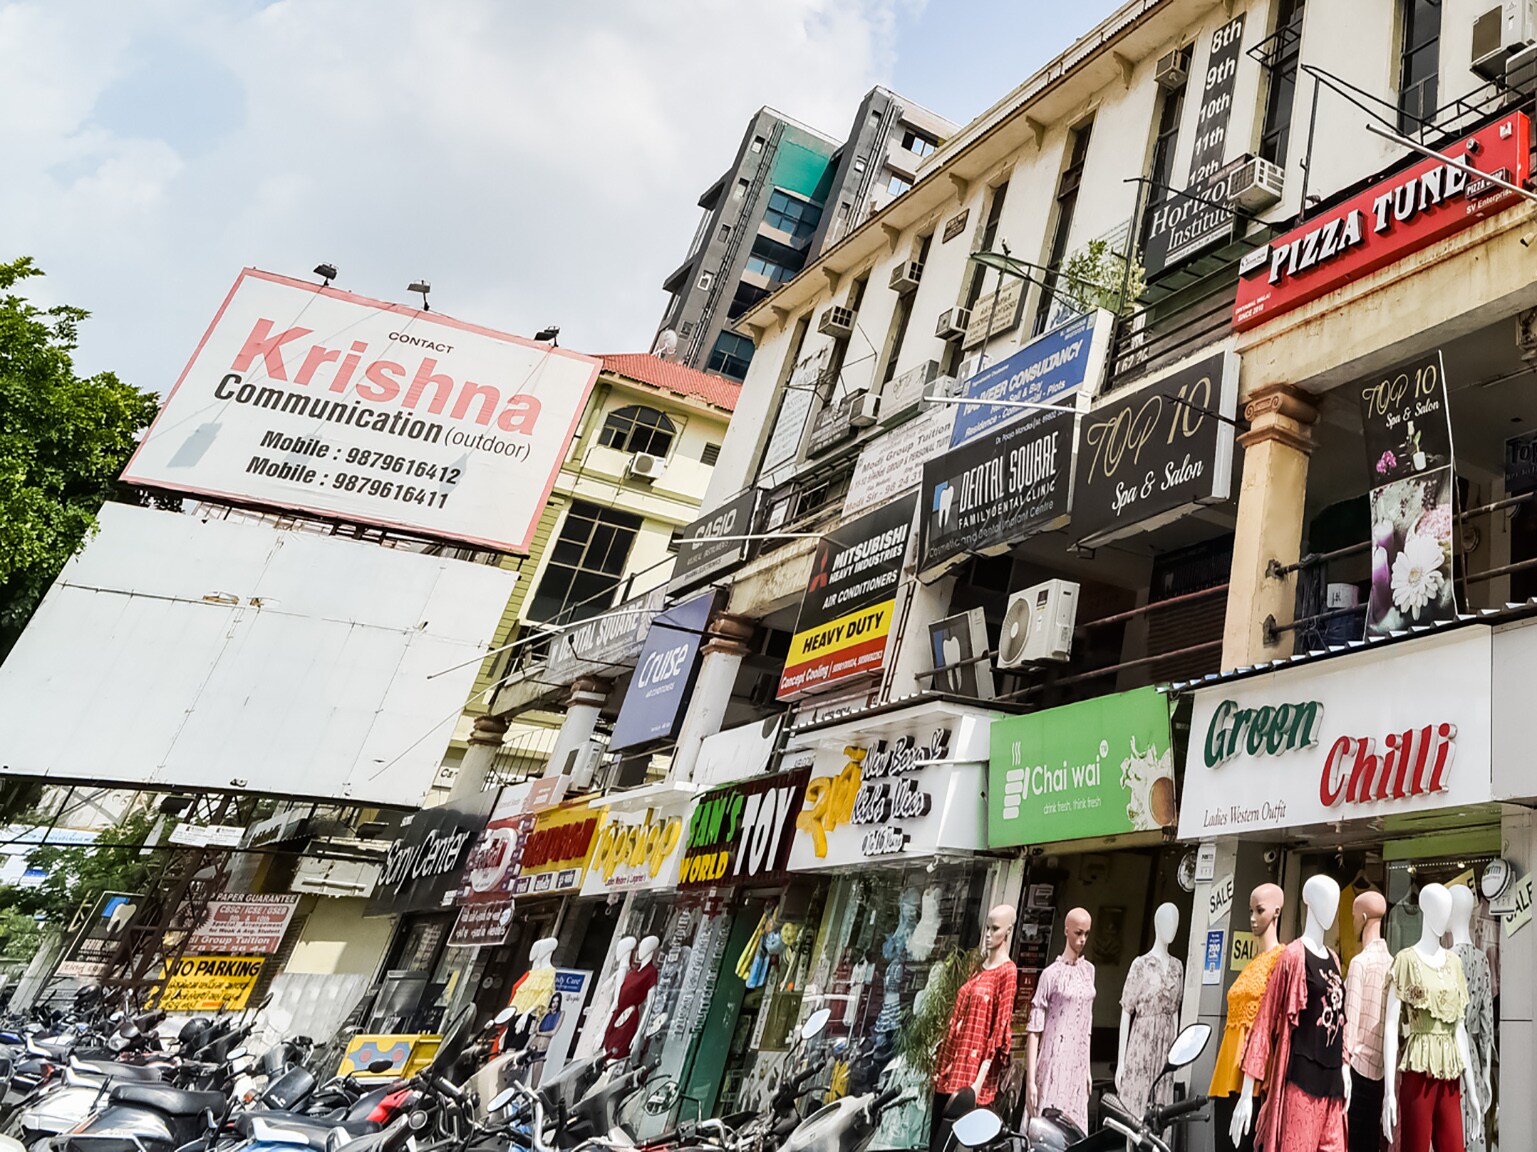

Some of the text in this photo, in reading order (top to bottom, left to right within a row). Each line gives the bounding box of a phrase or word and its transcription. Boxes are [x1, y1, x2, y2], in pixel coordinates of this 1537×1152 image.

[1211, 15, 1243, 55] 8th
[1205, 56, 1236, 92] 9th
[1199, 94, 1230, 125] 10th
[1195, 128, 1225, 157] 11th
[1189, 160, 1219, 186] 12th
[1268, 212, 1364, 285] PIZZA
[1372, 153, 1468, 235] TUNE
[388, 331, 454, 354] CONTACT
[230, 318, 542, 436] Krishna
[1008, 339, 1084, 392] CONSULTANCY
[1415, 365, 1437, 398] 10
[213, 373, 533, 462] Communication (outdoor)
[1167, 376, 1211, 445] 10
[1386, 398, 1439, 430] Spa & Salon
[260, 430, 330, 460] Mobile
[345, 446, 462, 485] 9879616412
[886, 442, 914, 463] Group
[917, 423, 951, 445] Tuition
[245, 456, 316, 486] Mobile
[332, 472, 450, 510] 9879616411
[959, 431, 1059, 514] DENTAL SQUARE
[1111, 453, 1204, 515] Spa & Salon
[958, 480, 1056, 530] FAMILY DENTAL CLINIC
[692, 508, 737, 550] CASIO
[832, 523, 909, 572] MITSUBISHI
[829, 543, 904, 585] HEAVY INDUSTRIES
[822, 569, 899, 611] AIR CONDITIONERS
[558, 600, 644, 663] DENTAL SQUARE
[802, 610, 885, 655] HEAVY DUTY
[638, 643, 689, 689] Cruise
[780, 670, 807, 691] Concept
[1204, 698, 1325, 770] Green
[1032, 755, 1101, 795] Chai wai
[1320, 721, 1458, 809] Chilli
[1044, 801, 1057, 815] drink
[1073, 797, 1087, 810] think
[1203, 801, 1287, 828] Ladies Western Outfit
[686, 793, 744, 850] SAM'S
[733, 786, 797, 877] TOY
[377, 838, 417, 895] Sony
[411, 825, 470, 881] Center
[679, 851, 729, 885] WORLD
[245, 893, 297, 904] GUARANTEE
[1209, 880, 1234, 914] SALE
[200, 935, 233, 946] Group
[235, 935, 271, 946] Tuition
[1233, 939, 1259, 960] SAL
[194, 960, 263, 978] PARKING
